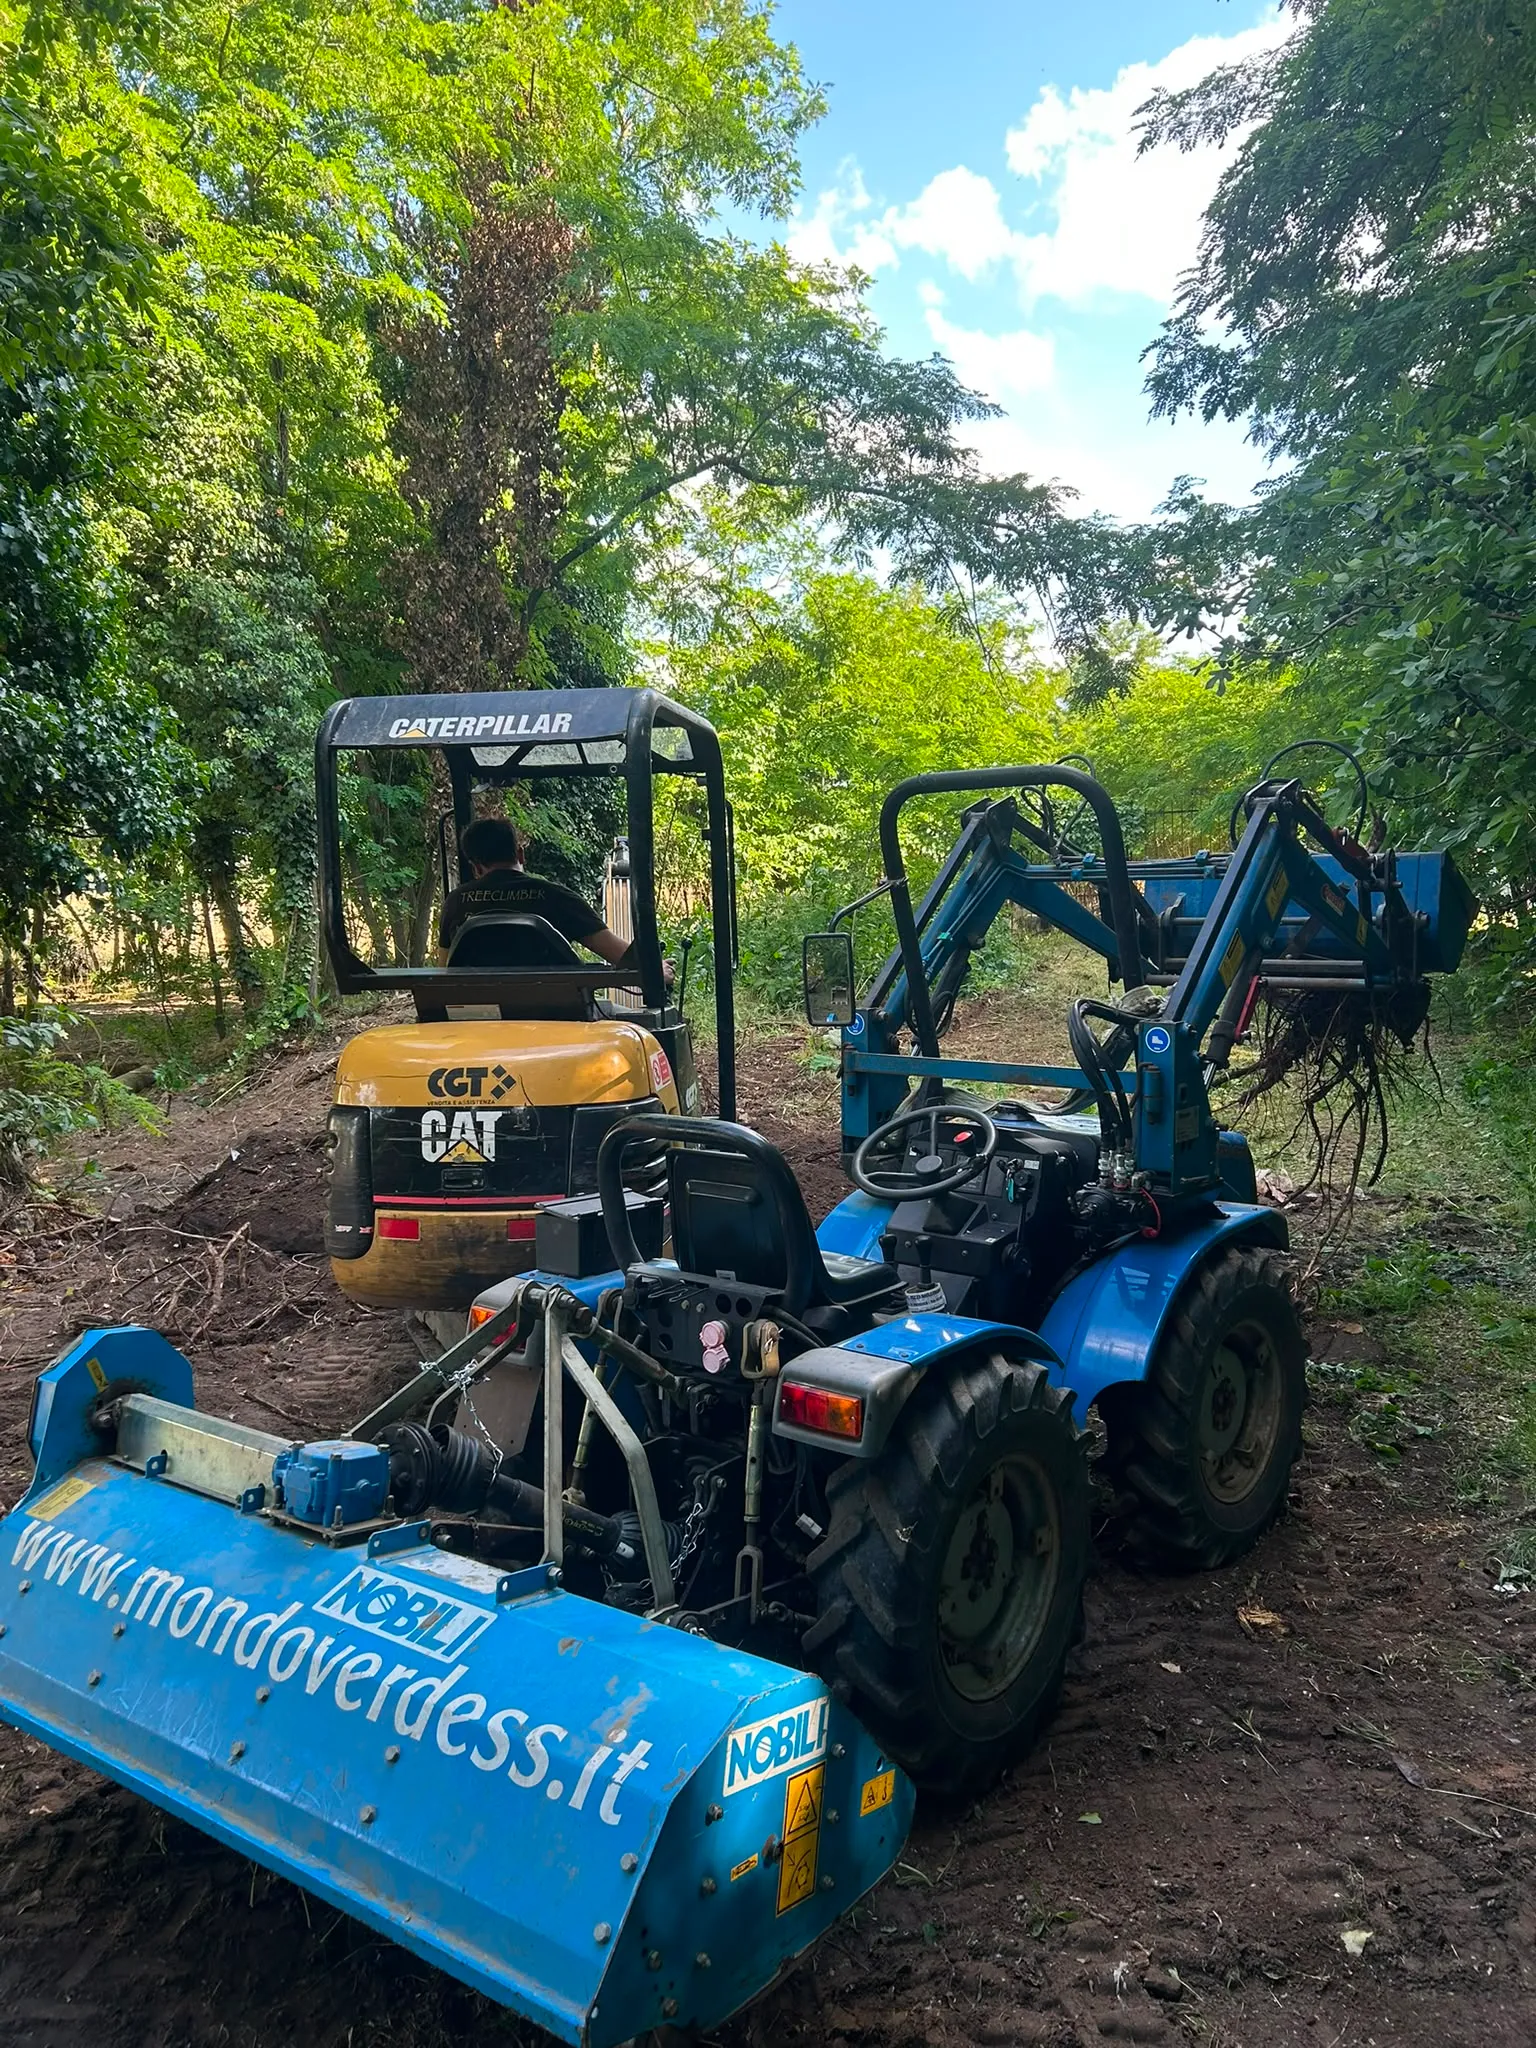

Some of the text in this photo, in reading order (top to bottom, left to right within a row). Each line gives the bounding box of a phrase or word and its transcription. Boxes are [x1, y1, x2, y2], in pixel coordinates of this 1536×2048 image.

[388, 714, 572, 738] CATERPILLAR
[461, 889, 545, 903] TREECLIMBER
[427, 1066, 488, 1097] CGT
[421, 1110, 503, 1162] CAT
[320, 1570, 489, 1657] NOBILI
[11, 1520, 652, 1825] www.mondoverdess.it
[728, 1703, 829, 1788] NOBILI
